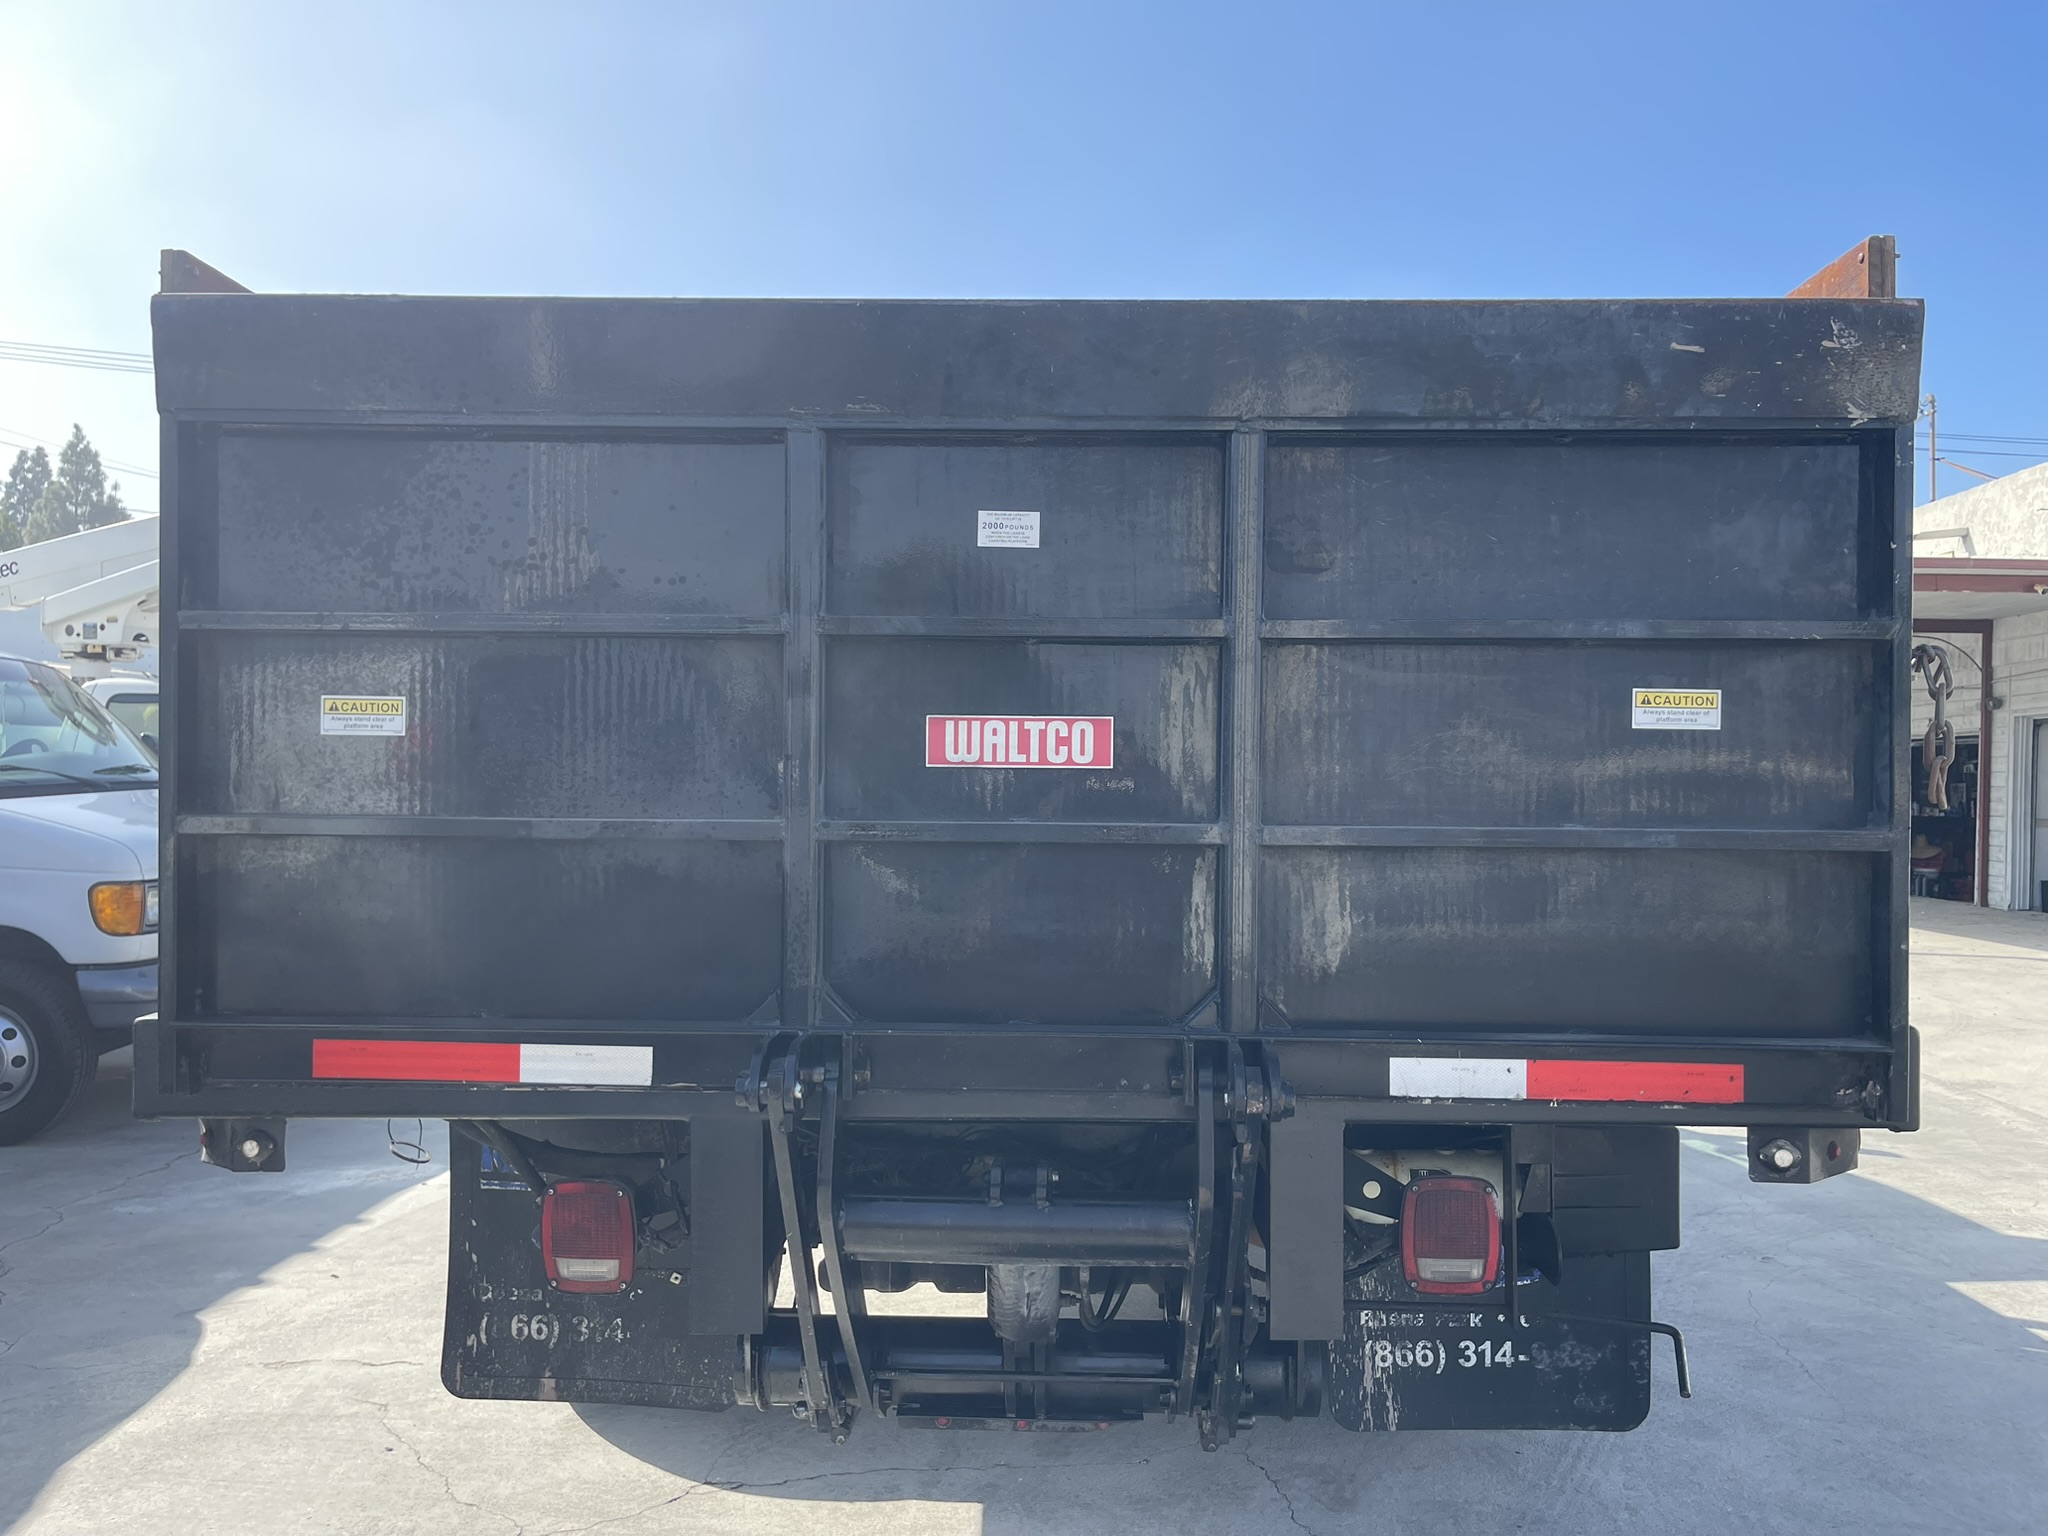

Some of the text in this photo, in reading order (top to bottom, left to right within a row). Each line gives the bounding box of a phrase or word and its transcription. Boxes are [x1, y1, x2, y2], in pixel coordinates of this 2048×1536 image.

[341, 702, 399, 713] CAUTION
[1653, 695, 1714, 706] CAUTION
[945, 720, 1094, 764] WALTCO
[479, 1312, 559, 1349] (66)
[1364, 1339, 1447, 1374] (866)
